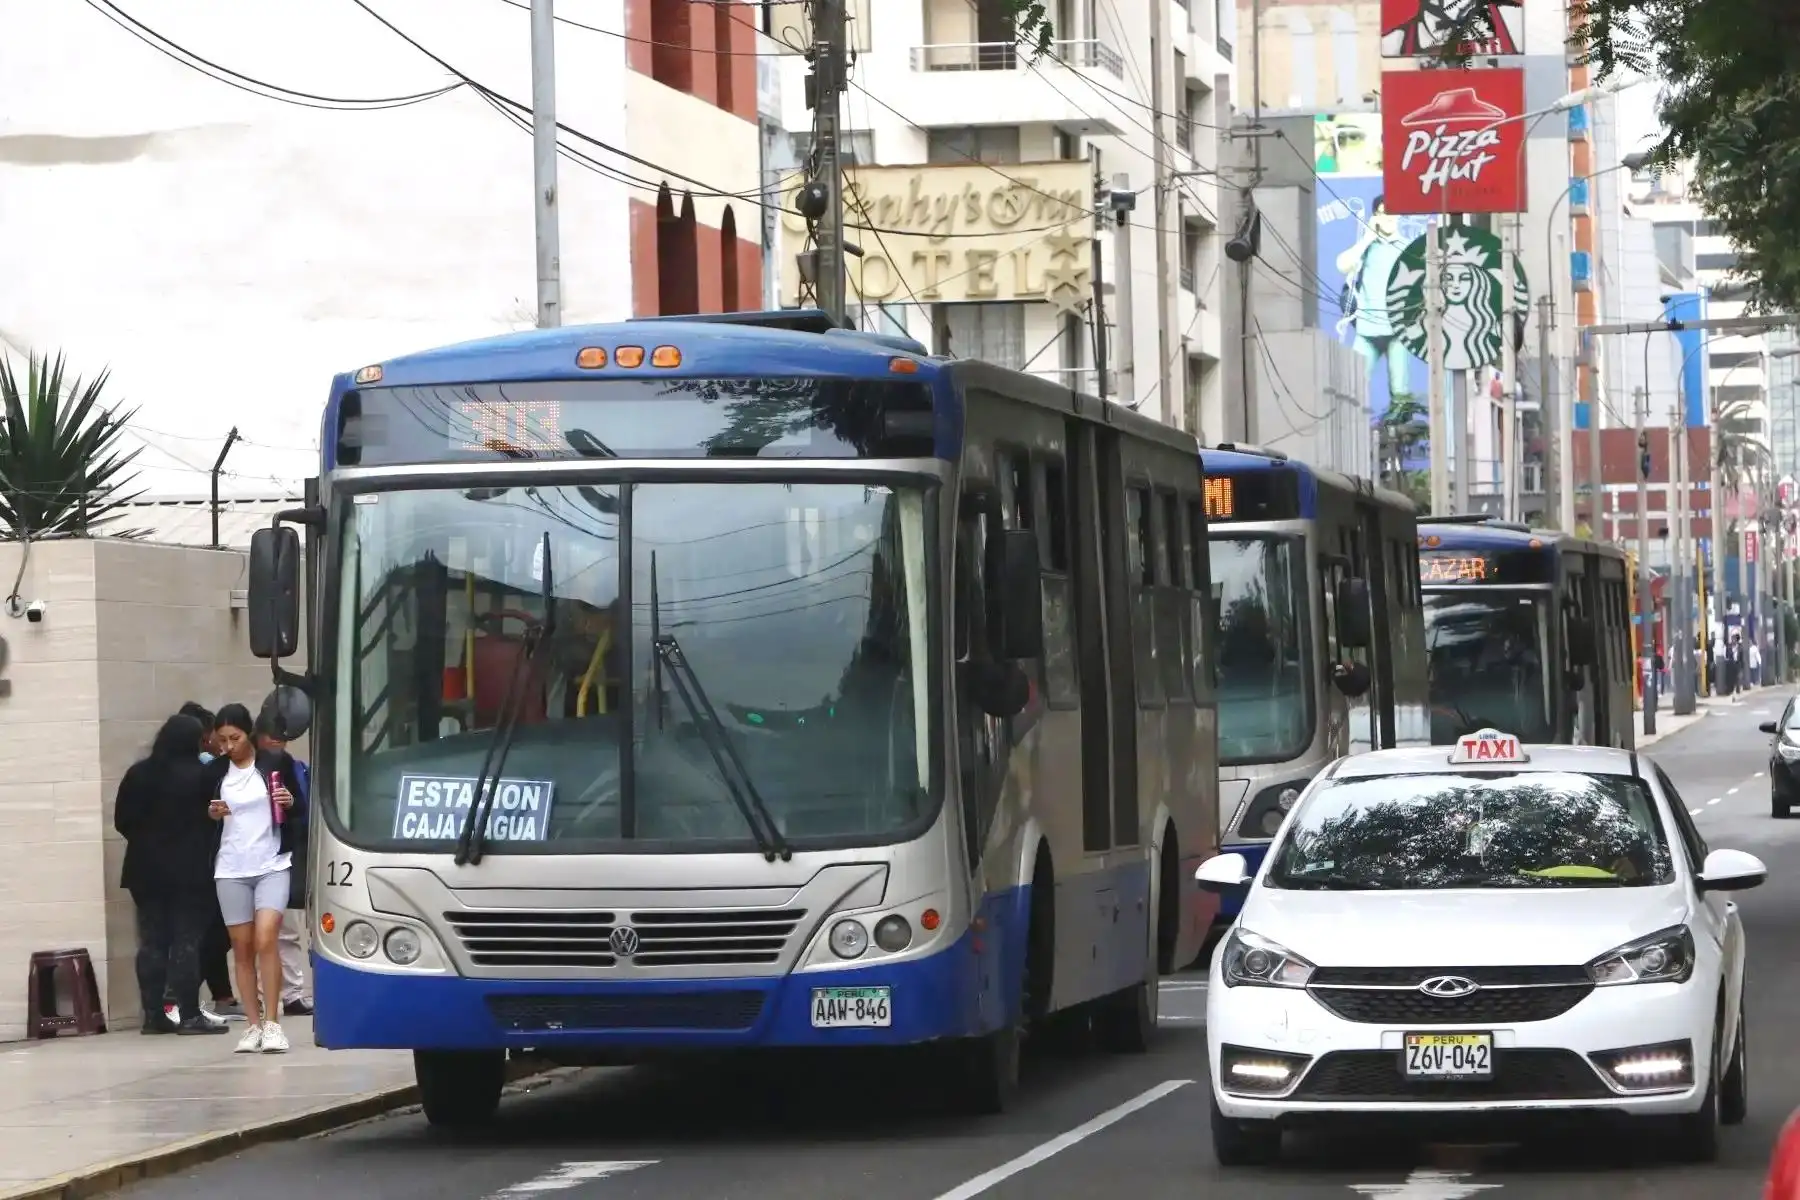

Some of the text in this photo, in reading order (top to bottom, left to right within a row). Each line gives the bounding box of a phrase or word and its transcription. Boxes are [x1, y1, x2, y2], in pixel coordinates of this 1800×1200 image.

[1402, 124, 1500, 171] Pizza
[1419, 152, 1496, 194] Hut
[793, 250, 1048, 300] OTEL
[463, 401, 559, 451] 303
[1462, 740, 1515, 760] TAXI
[402, 812, 456, 840] CAJA
[326, 861, 354, 887] 12
[837, 990, 865, 998] PERU
[815, 998, 888, 1021] AAW-846
[1433, 1036, 1464, 1044] PERU
[1409, 1044, 1489, 1070] Z6V-042
